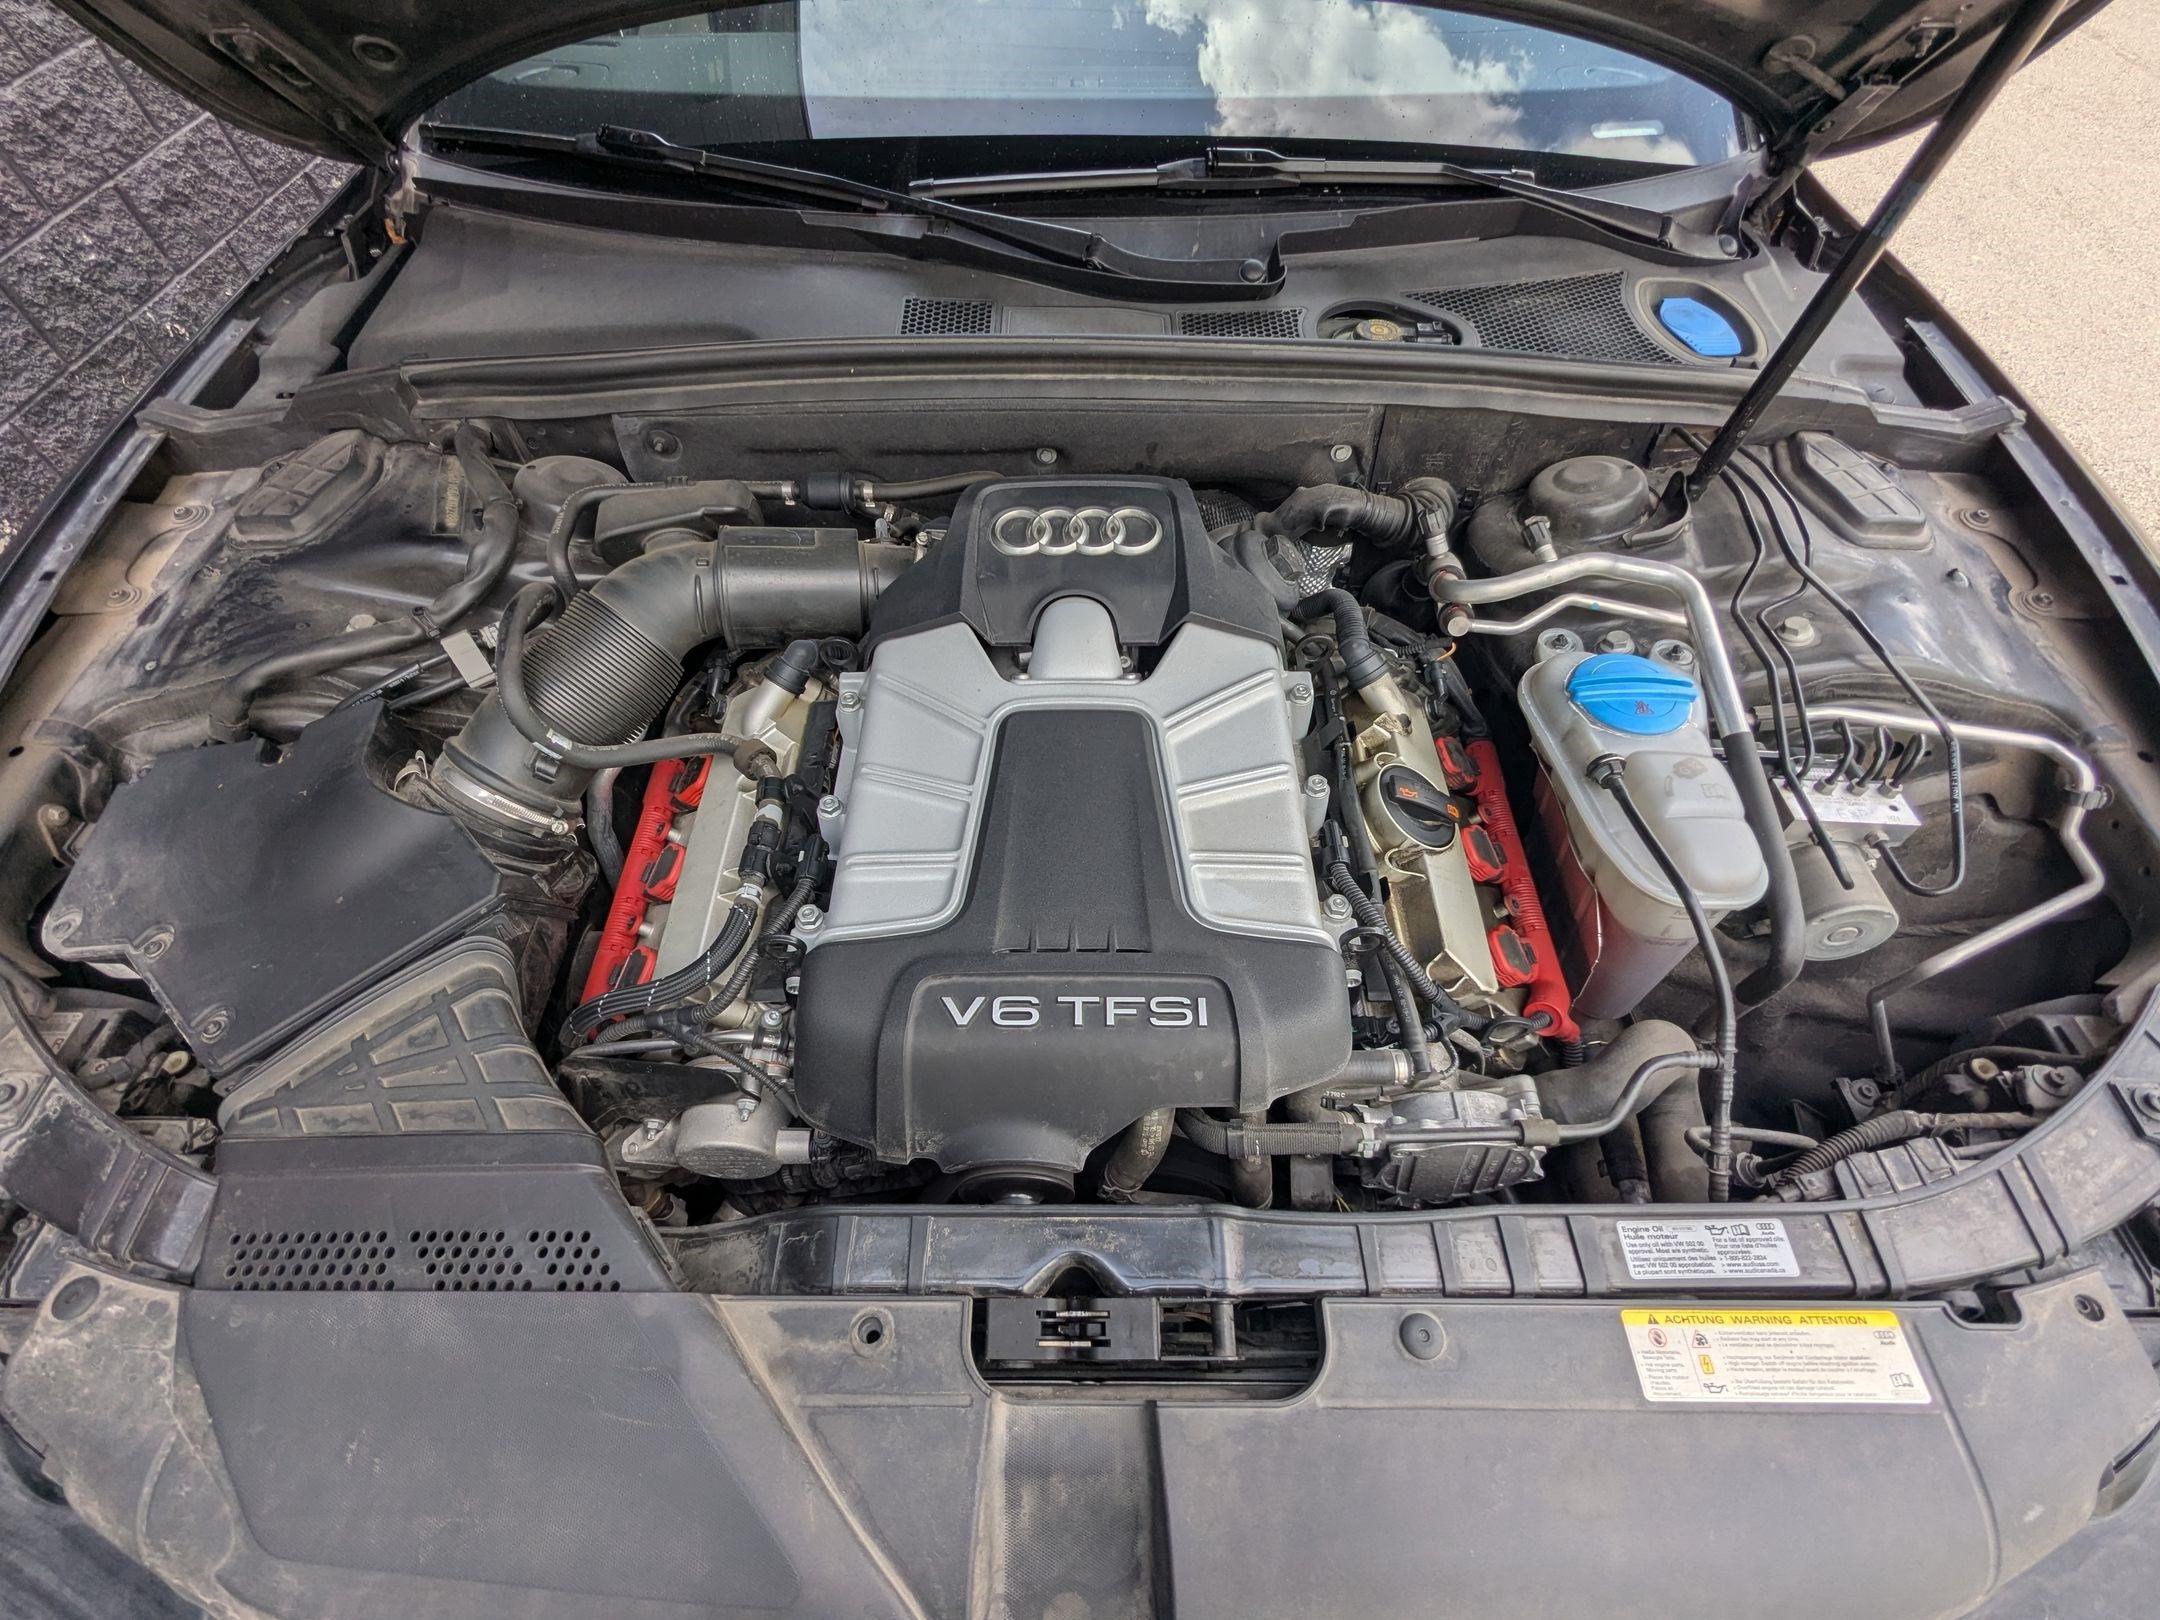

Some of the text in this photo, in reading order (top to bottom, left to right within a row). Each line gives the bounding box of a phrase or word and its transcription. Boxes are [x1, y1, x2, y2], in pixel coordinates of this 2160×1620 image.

[941, 996, 1208, 1027] V6 TFSI
[1622, 1226, 1650, 1234] Engine
[1665, 1315, 1868, 1325] ACHTUNG WARNING ATTENTION
